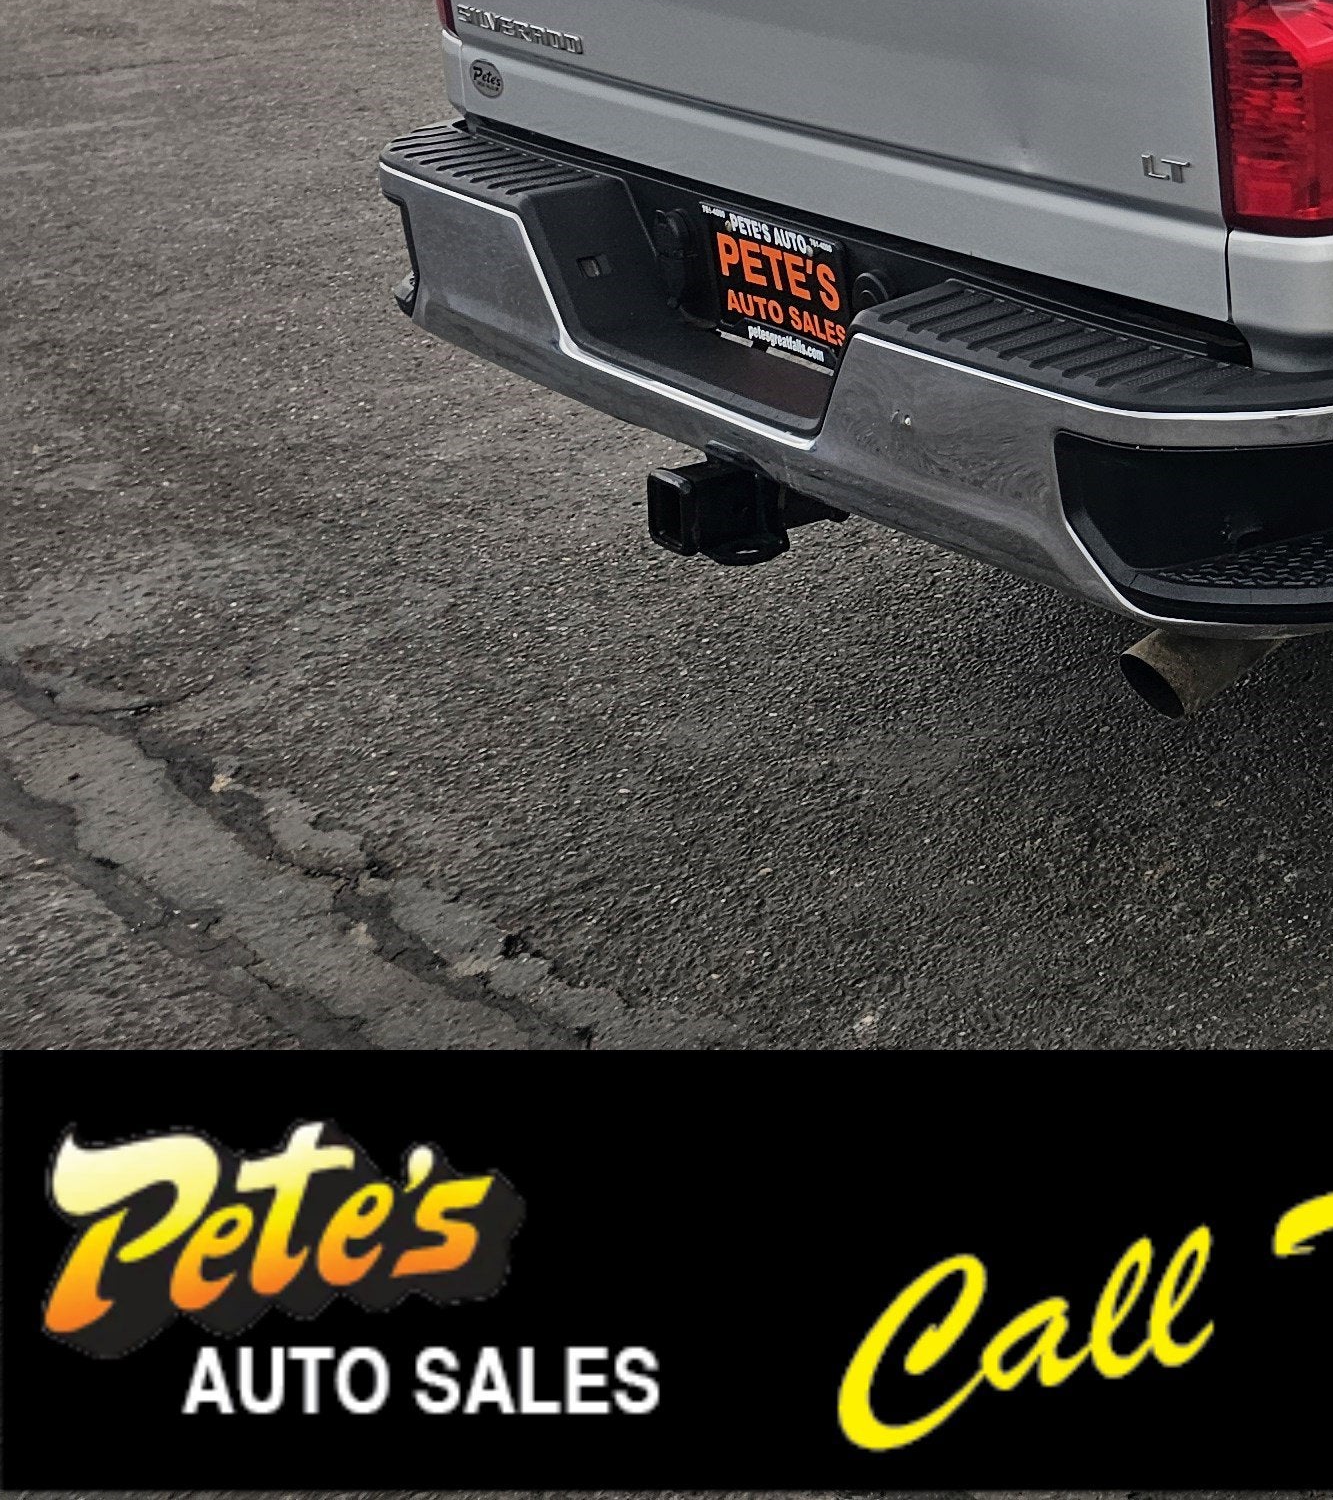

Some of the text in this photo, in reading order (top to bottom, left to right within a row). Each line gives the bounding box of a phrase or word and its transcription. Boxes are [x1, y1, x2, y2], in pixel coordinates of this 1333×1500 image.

[456, 3, 584, 55] SILVERADO
[1141, 154, 1191, 184] LT
[729, 212, 808, 255] PETE'S AUTO
[716, 231, 841, 312] PETE'S
[727, 289, 847, 347] AUTO SALES
